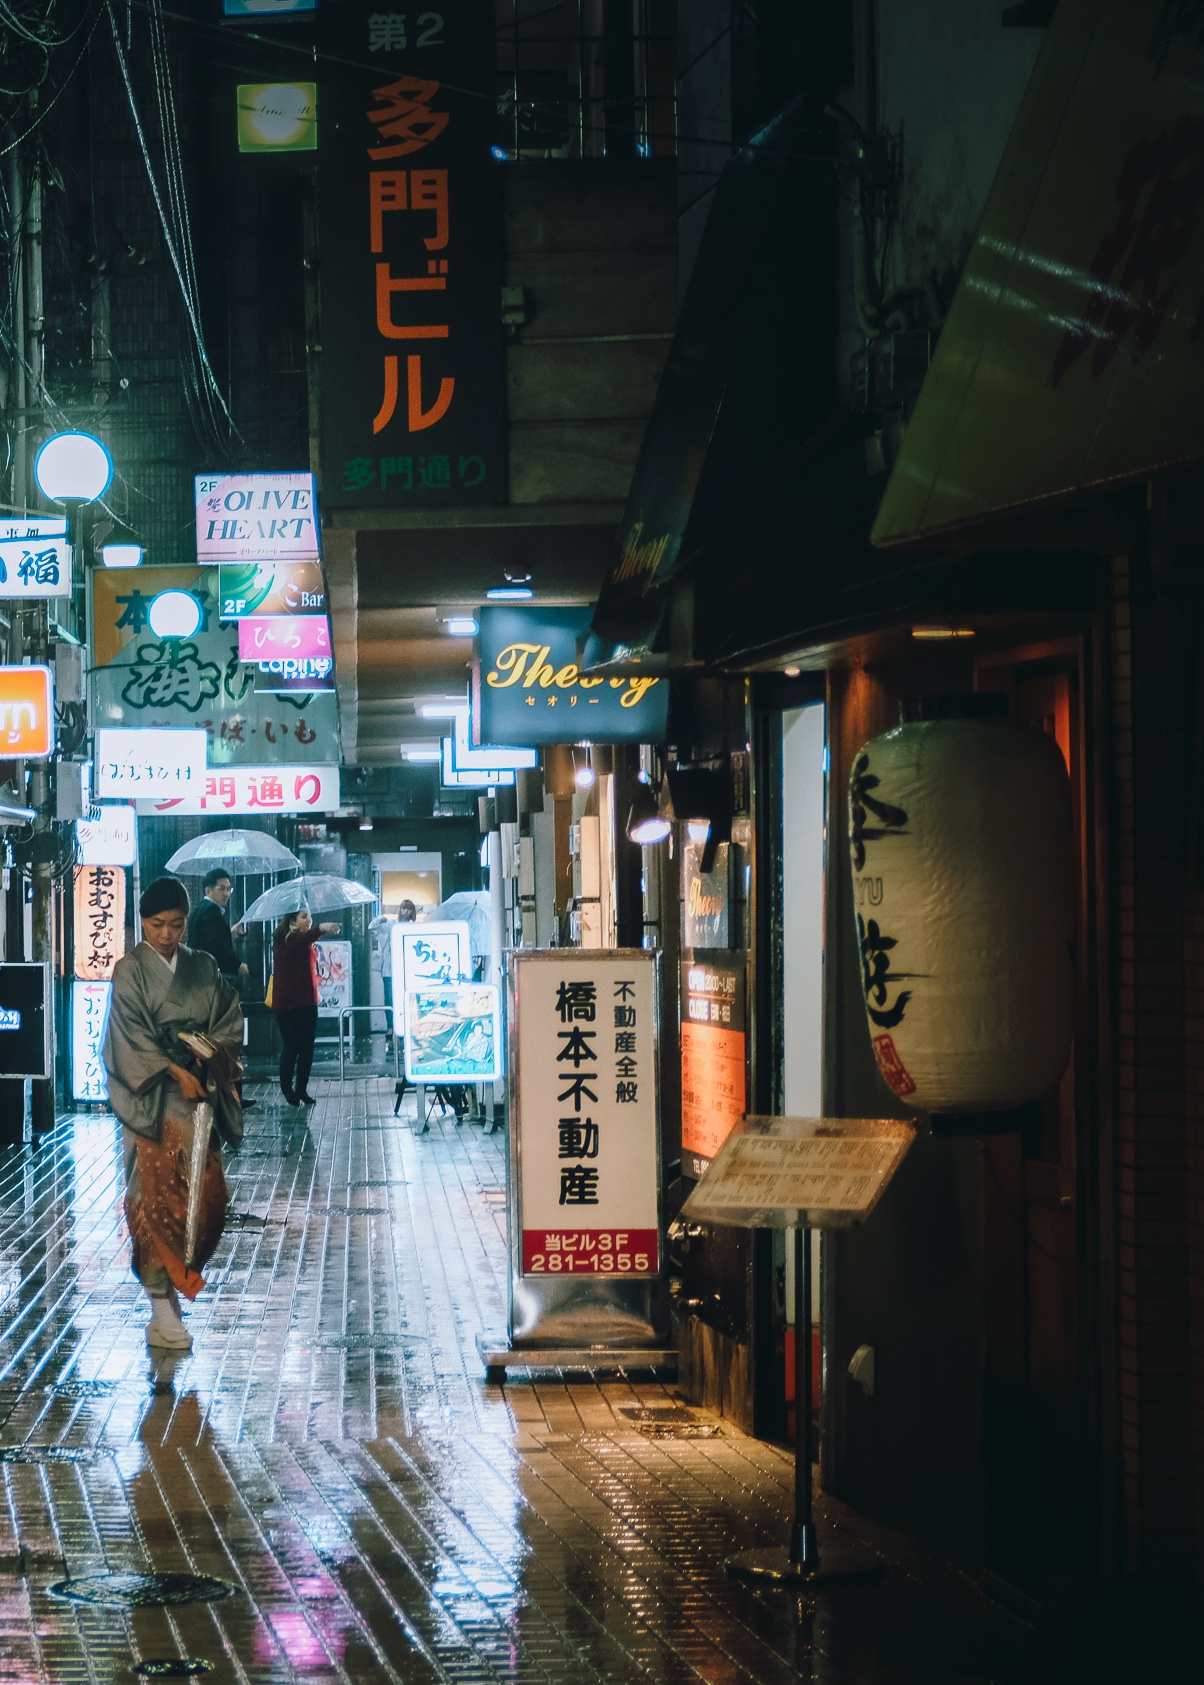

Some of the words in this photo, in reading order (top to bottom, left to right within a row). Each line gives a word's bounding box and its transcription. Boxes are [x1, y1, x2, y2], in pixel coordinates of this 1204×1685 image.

[368, 12, 445, 52] 第2
[366, 75, 455, 435] 多門ビル
[343, 455, 486, 492] 多門通り
[200, 481, 217, 492] 2F
[224, 489, 311, 511] OLIVE
[205, 518, 311, 540] HEART
[223, 599, 247, 614] 2F
[301, 591, 324, 608] Bar
[253, 622, 327, 649] ひろこ
[524, 695, 600, 707] セオリー
[688, 876, 723, 934] Theory
[88, 865, 114, 969] おむすび村
[688, 999, 709, 1020] CLOSE
[613, 980, 638, 1104] 不動産全般
[555, 980, 600, 1205] 橋本不動産
[544, 1234, 629, 1252] 当ビル3F
[531, 1253, 649, 1272] 281-1355
